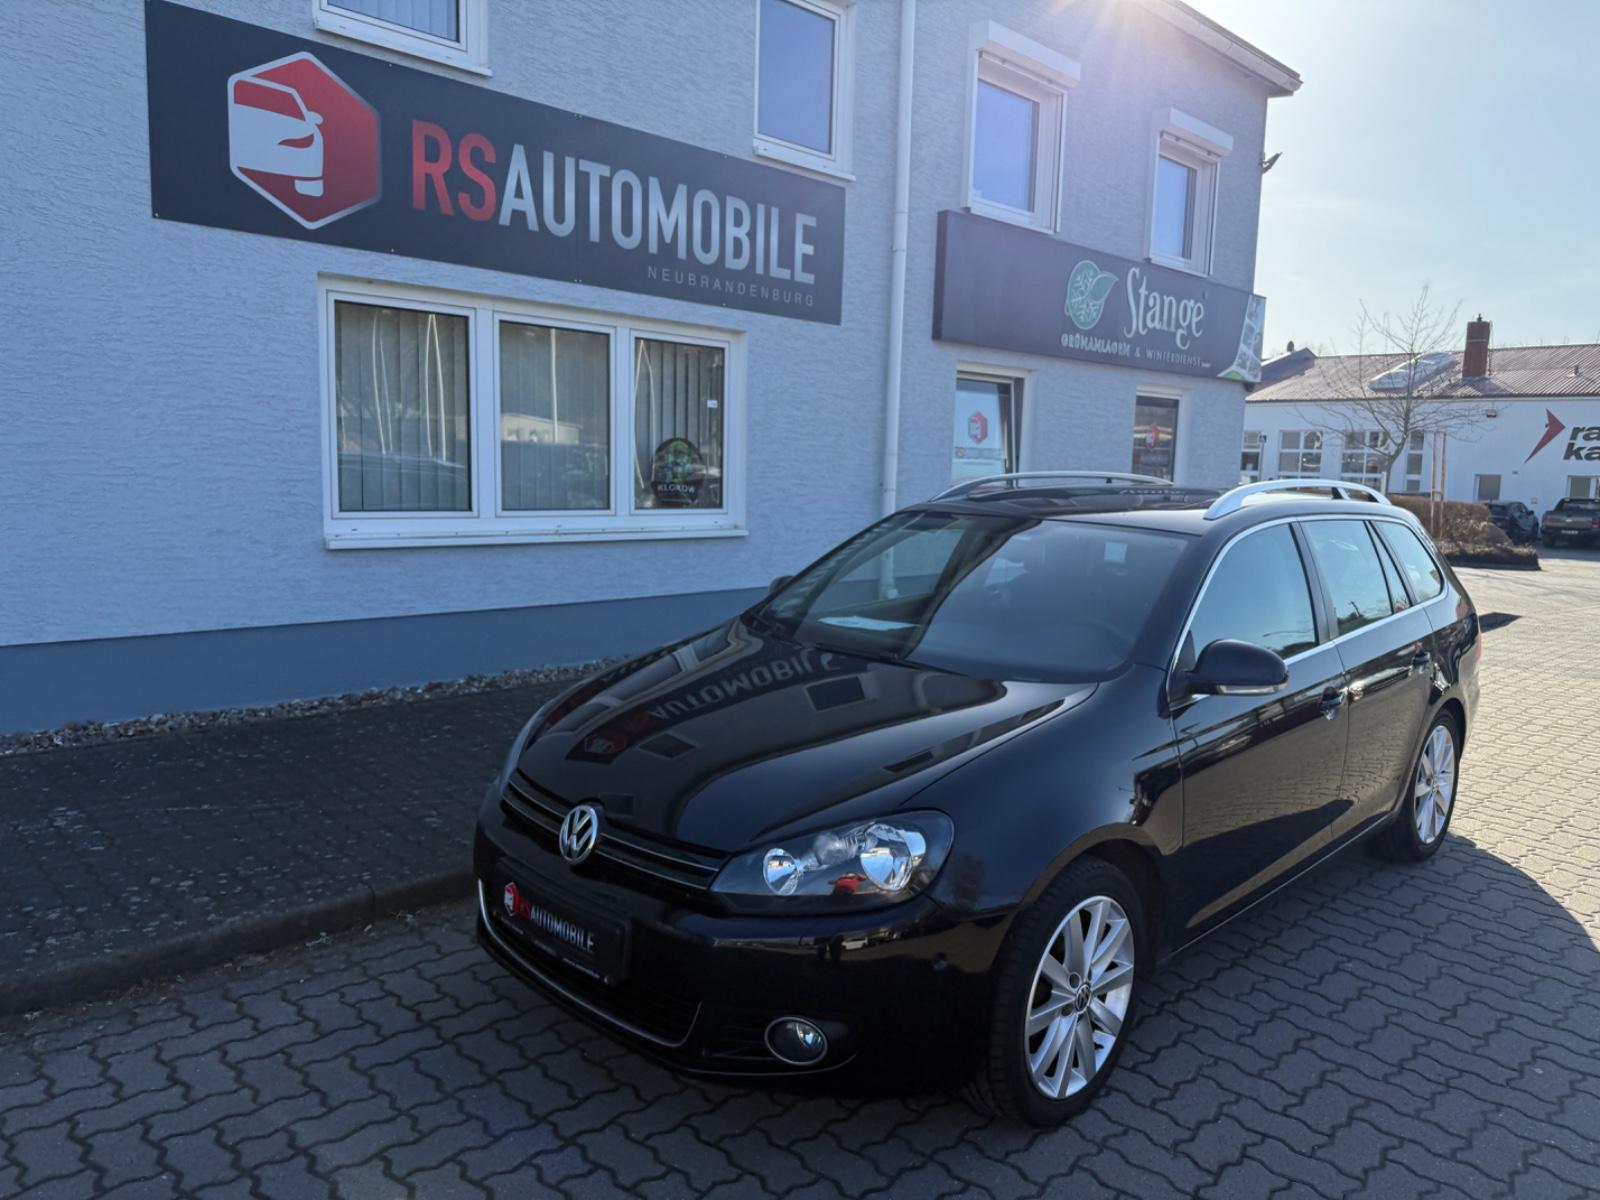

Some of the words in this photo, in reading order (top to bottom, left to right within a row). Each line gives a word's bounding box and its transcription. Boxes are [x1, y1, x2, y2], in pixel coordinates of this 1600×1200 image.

[647, 266, 815, 307] NEUBRANDENBURG
[1123, 267, 1204, 349] Stange
[1147, 350, 1201, 368] WINTERDIENST
[1570, 426, 1600, 441] ra
[1563, 442, 1600, 461] ka
